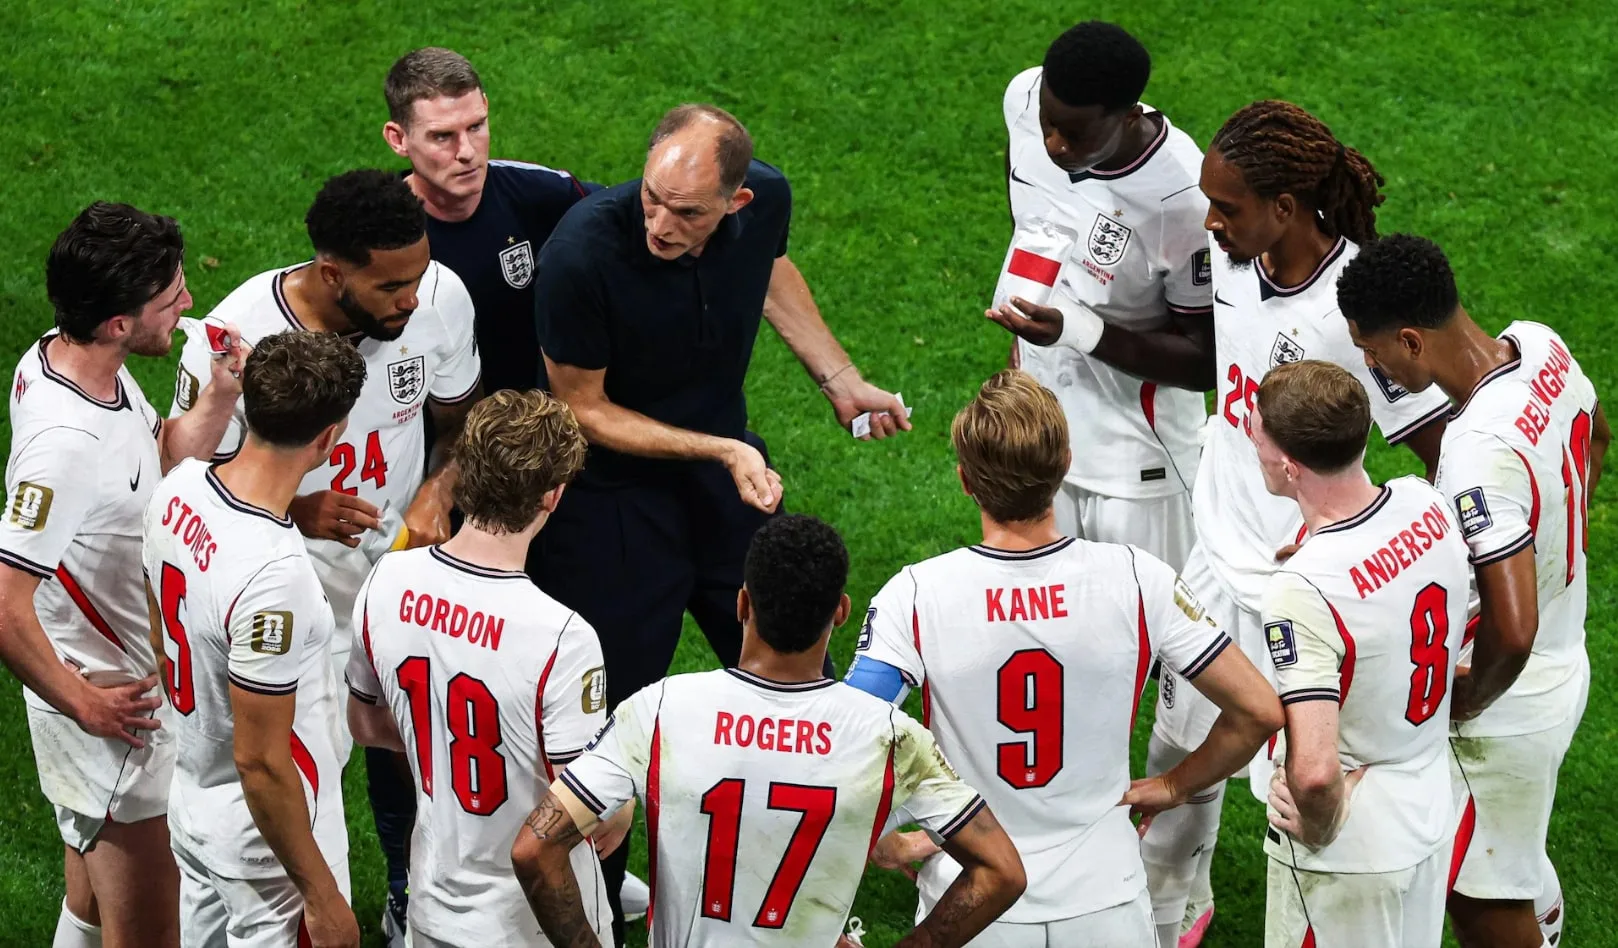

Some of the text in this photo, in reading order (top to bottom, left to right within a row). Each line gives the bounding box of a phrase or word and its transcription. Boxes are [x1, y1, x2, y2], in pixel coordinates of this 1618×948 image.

[1514, 338, 1571, 447] BELNGHAM
[330, 430, 388, 496] 24
[162, 495, 218, 573] STONES
[1348, 501, 1451, 600] ANDERSON
[160, 560, 196, 717] 5
[400, 589, 505, 651] GORDON
[985, 583, 1068, 623] KANE
[1404, 581, 1449, 728] 8
[395, 655, 509, 817] 18
[713, 711, 833, 756] ROGERS
[996, 648, 1065, 791] 9
[699, 777, 838, 931] 17
